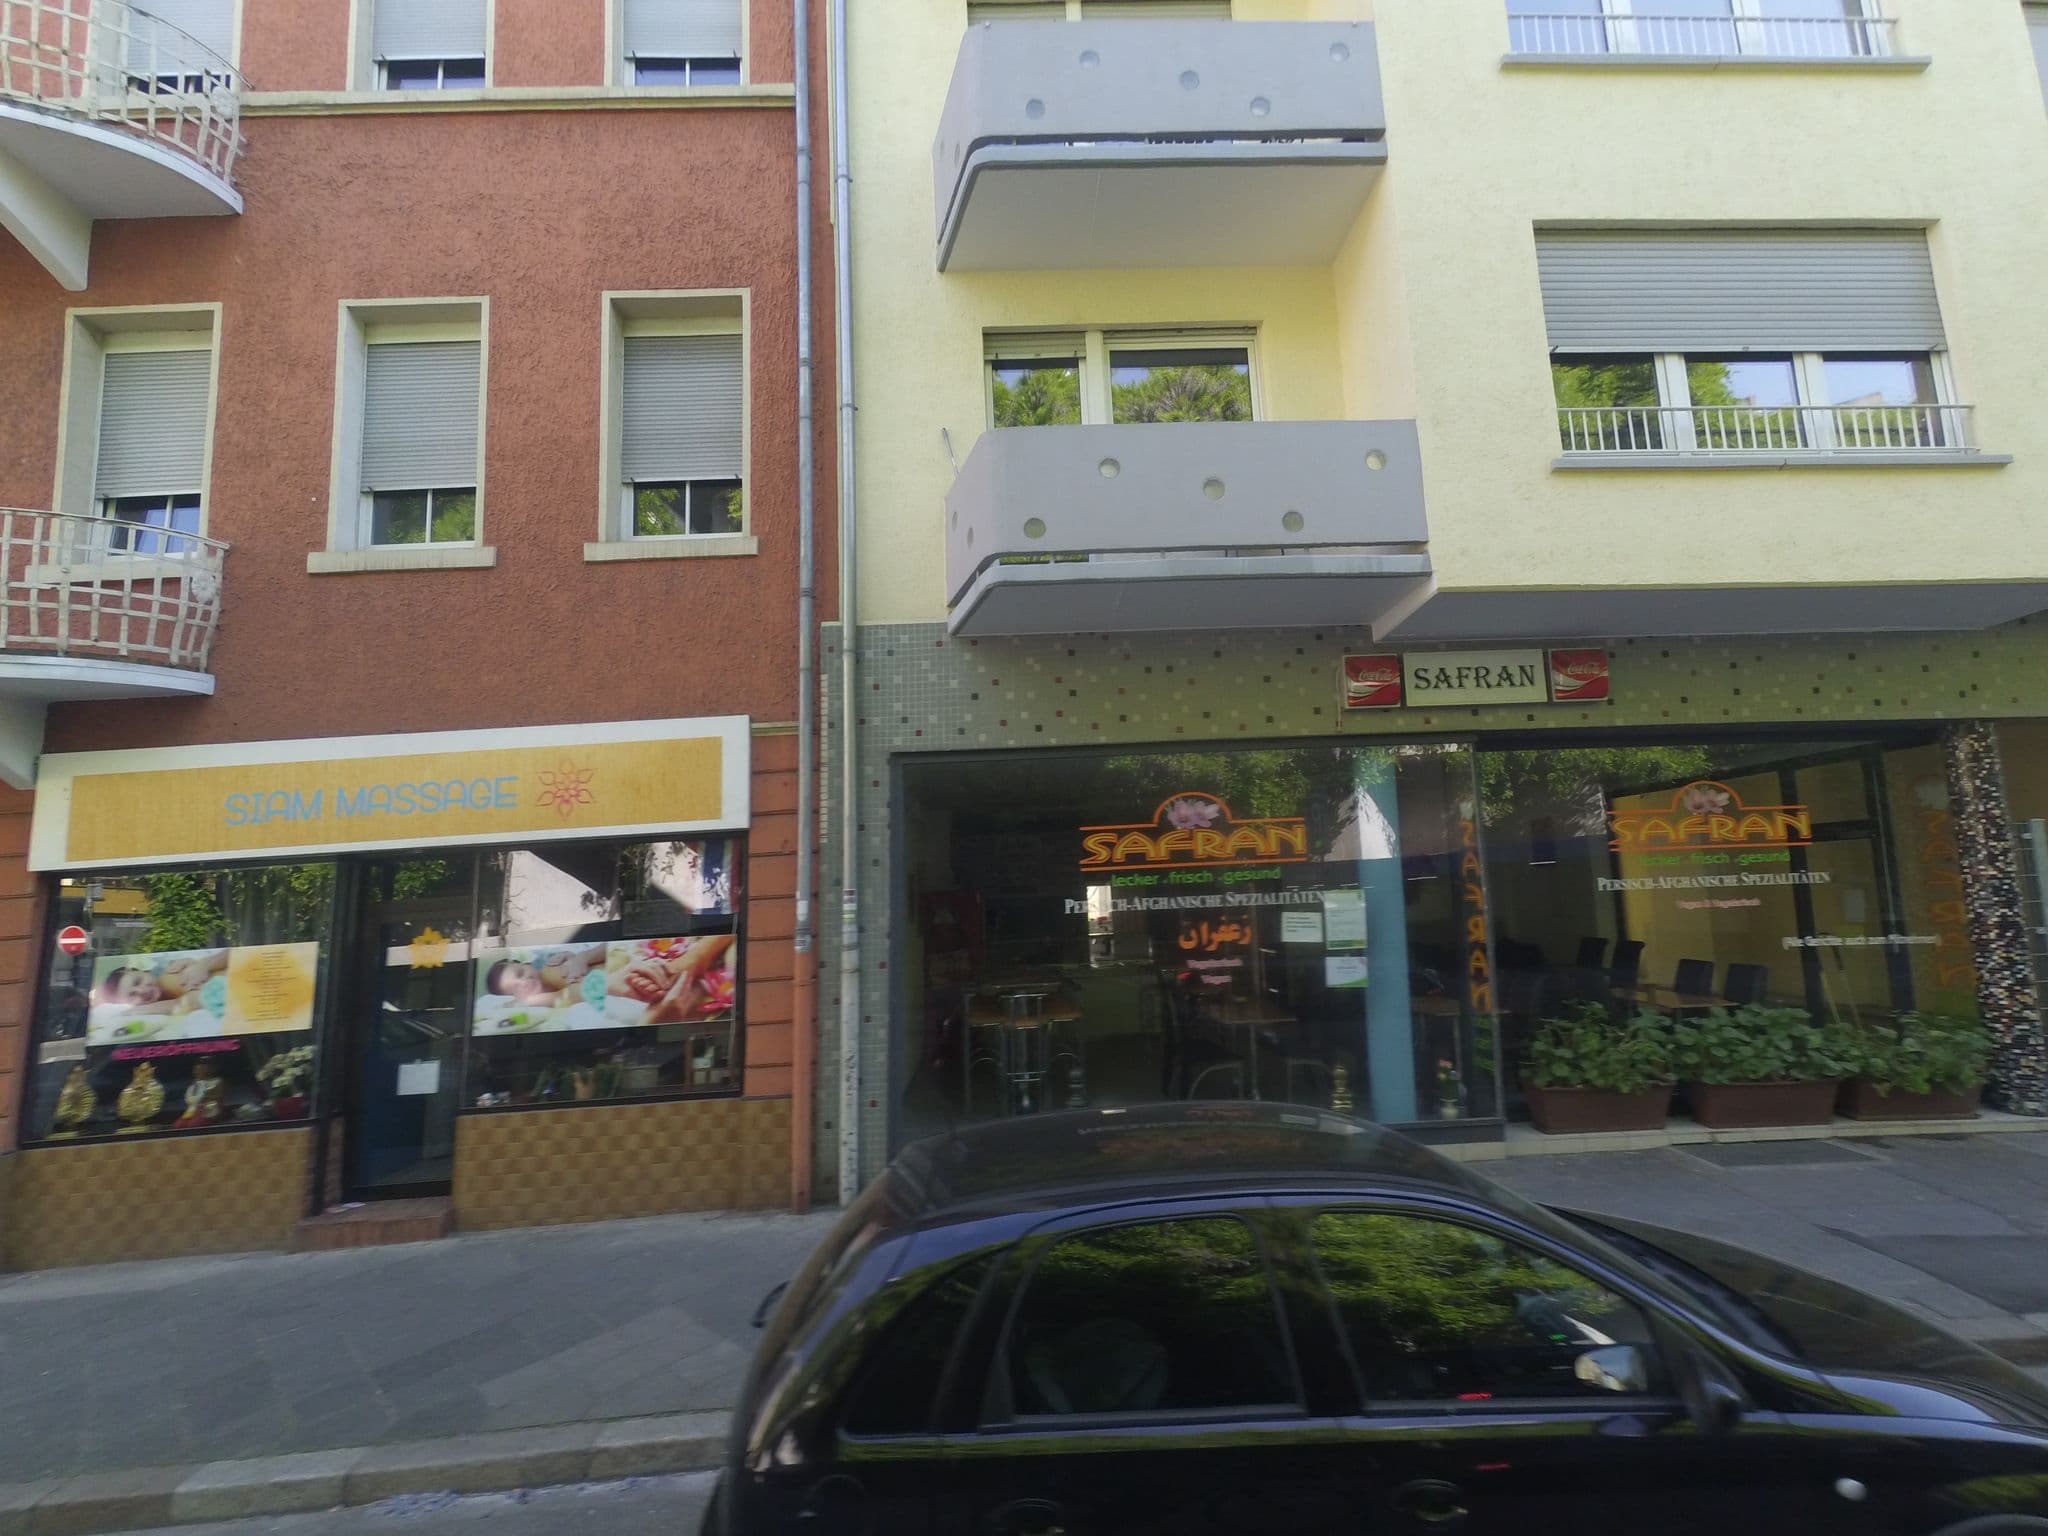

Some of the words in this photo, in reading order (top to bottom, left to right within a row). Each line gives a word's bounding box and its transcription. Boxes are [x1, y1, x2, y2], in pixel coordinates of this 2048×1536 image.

[1413, 664, 1536, 690] SAFRAN
[225, 784, 323, 827] SIAM
[336, 774, 520, 820] MASSAGE
[1080, 825, 1307, 865] SAFRAN
[1608, 811, 1812, 846] SAFRAN
[1111, 870, 1160, 888] lecker
[1167, 869, 1213, 885] frisch
[1222, 866, 1282, 885] gesund
